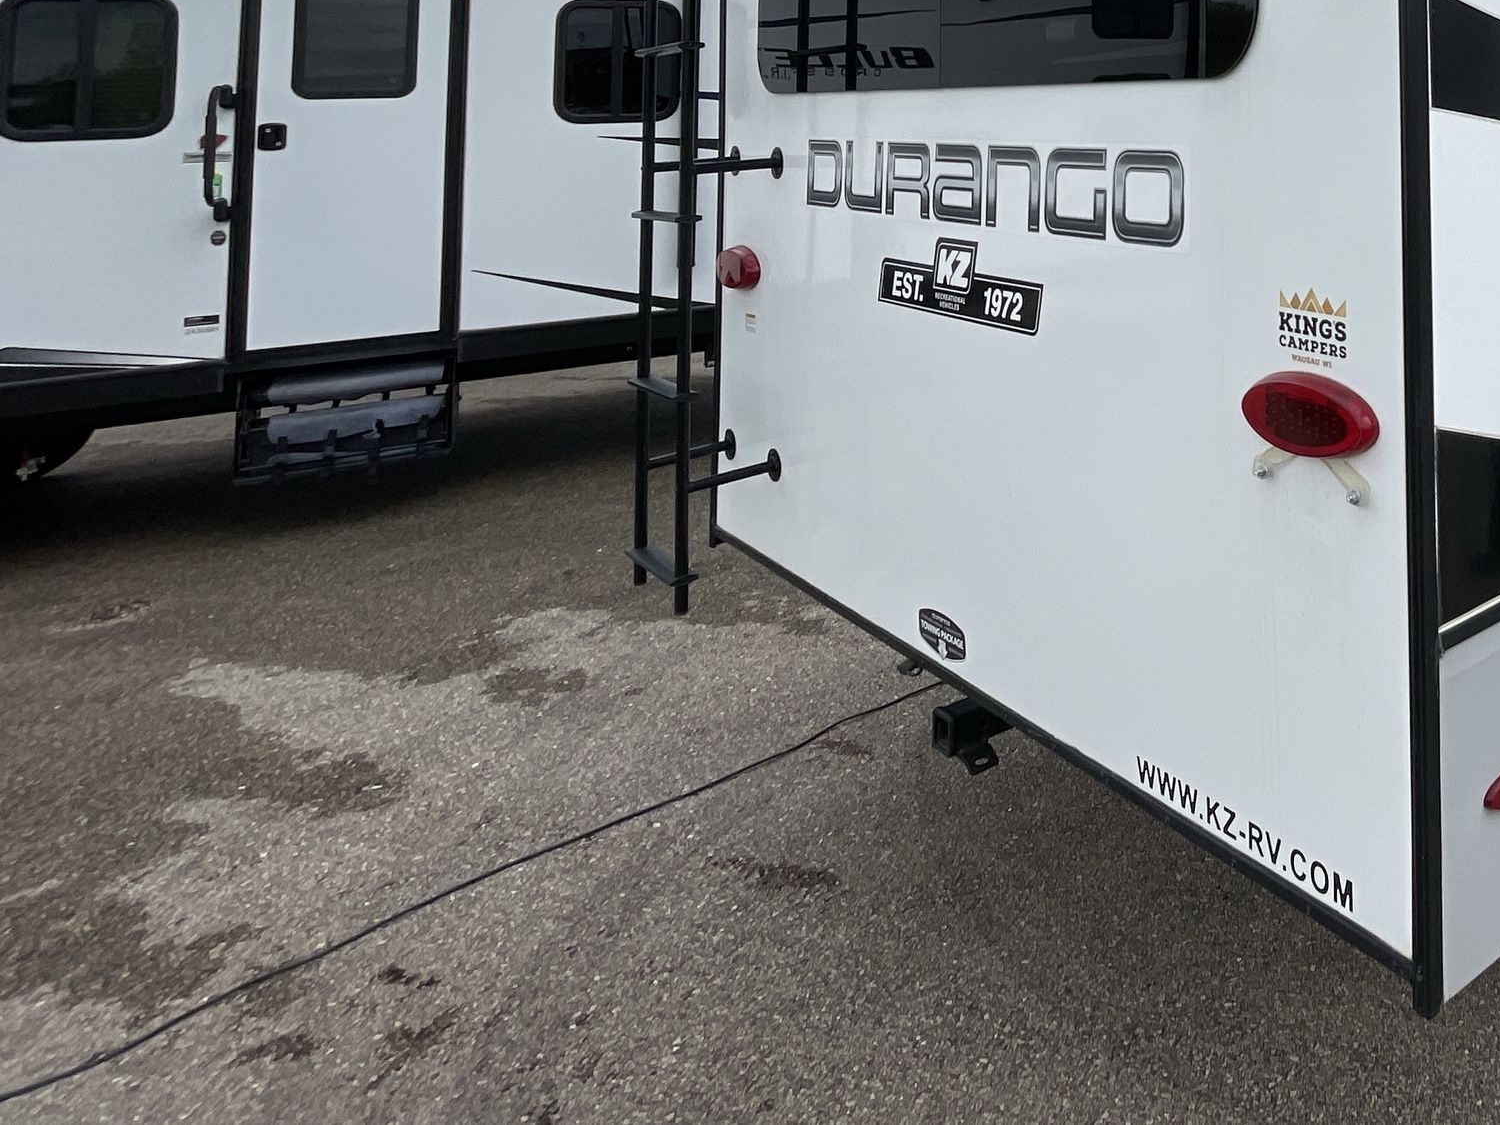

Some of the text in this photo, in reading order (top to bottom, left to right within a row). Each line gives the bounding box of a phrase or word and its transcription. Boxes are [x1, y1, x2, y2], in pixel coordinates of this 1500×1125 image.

[806, 138, 1185, 248] DURANGO
[936, 248, 971, 288] KZ
[891, 270, 1024, 322] EST. 1972
[1278, 334, 1347, 359] CAMPERS
[920, 619, 940, 637] TOWING
[1135, 755, 1354, 913] WWW.KZ-RV.COM
